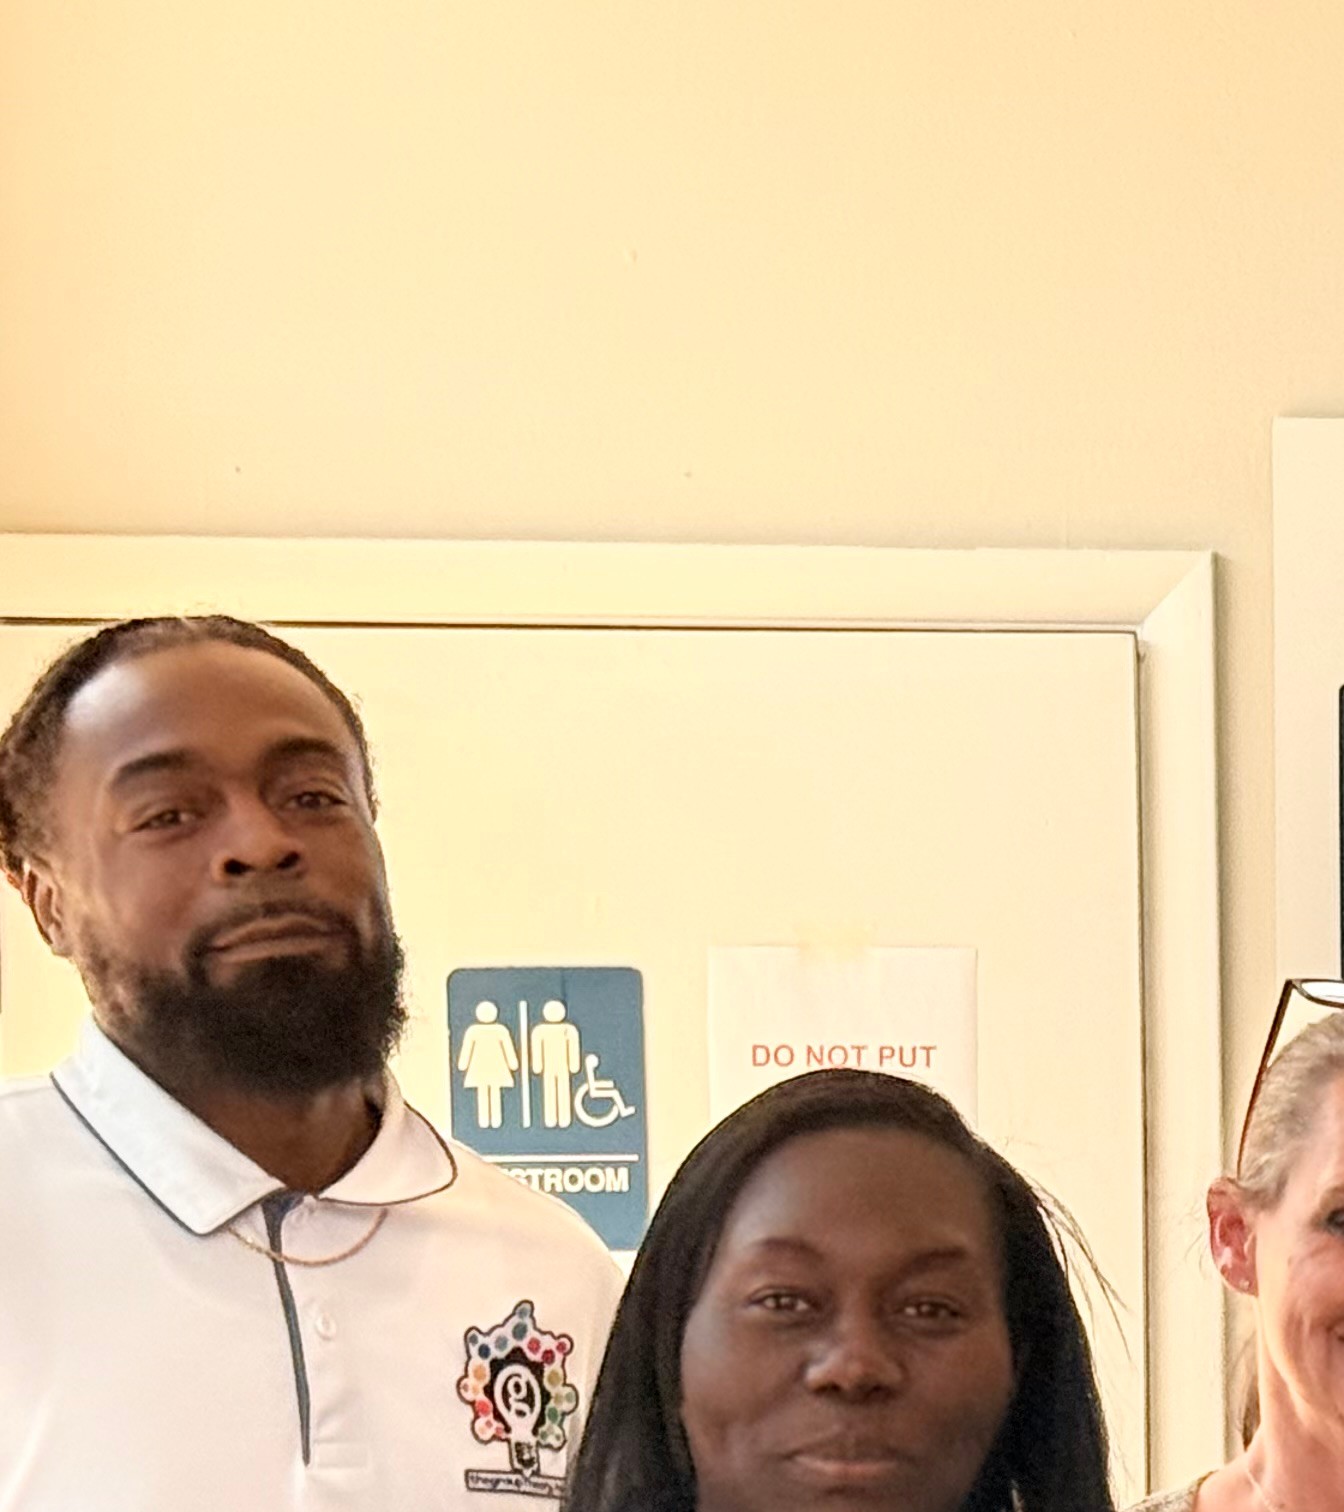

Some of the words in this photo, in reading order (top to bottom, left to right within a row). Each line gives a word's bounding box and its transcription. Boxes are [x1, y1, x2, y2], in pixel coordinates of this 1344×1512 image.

[752, 1044, 794, 1068] DO
[806, 1044, 869, 1069] NOT
[879, 1045, 938, 1069] PUT
[500, 1166, 630, 1193] STROOM
